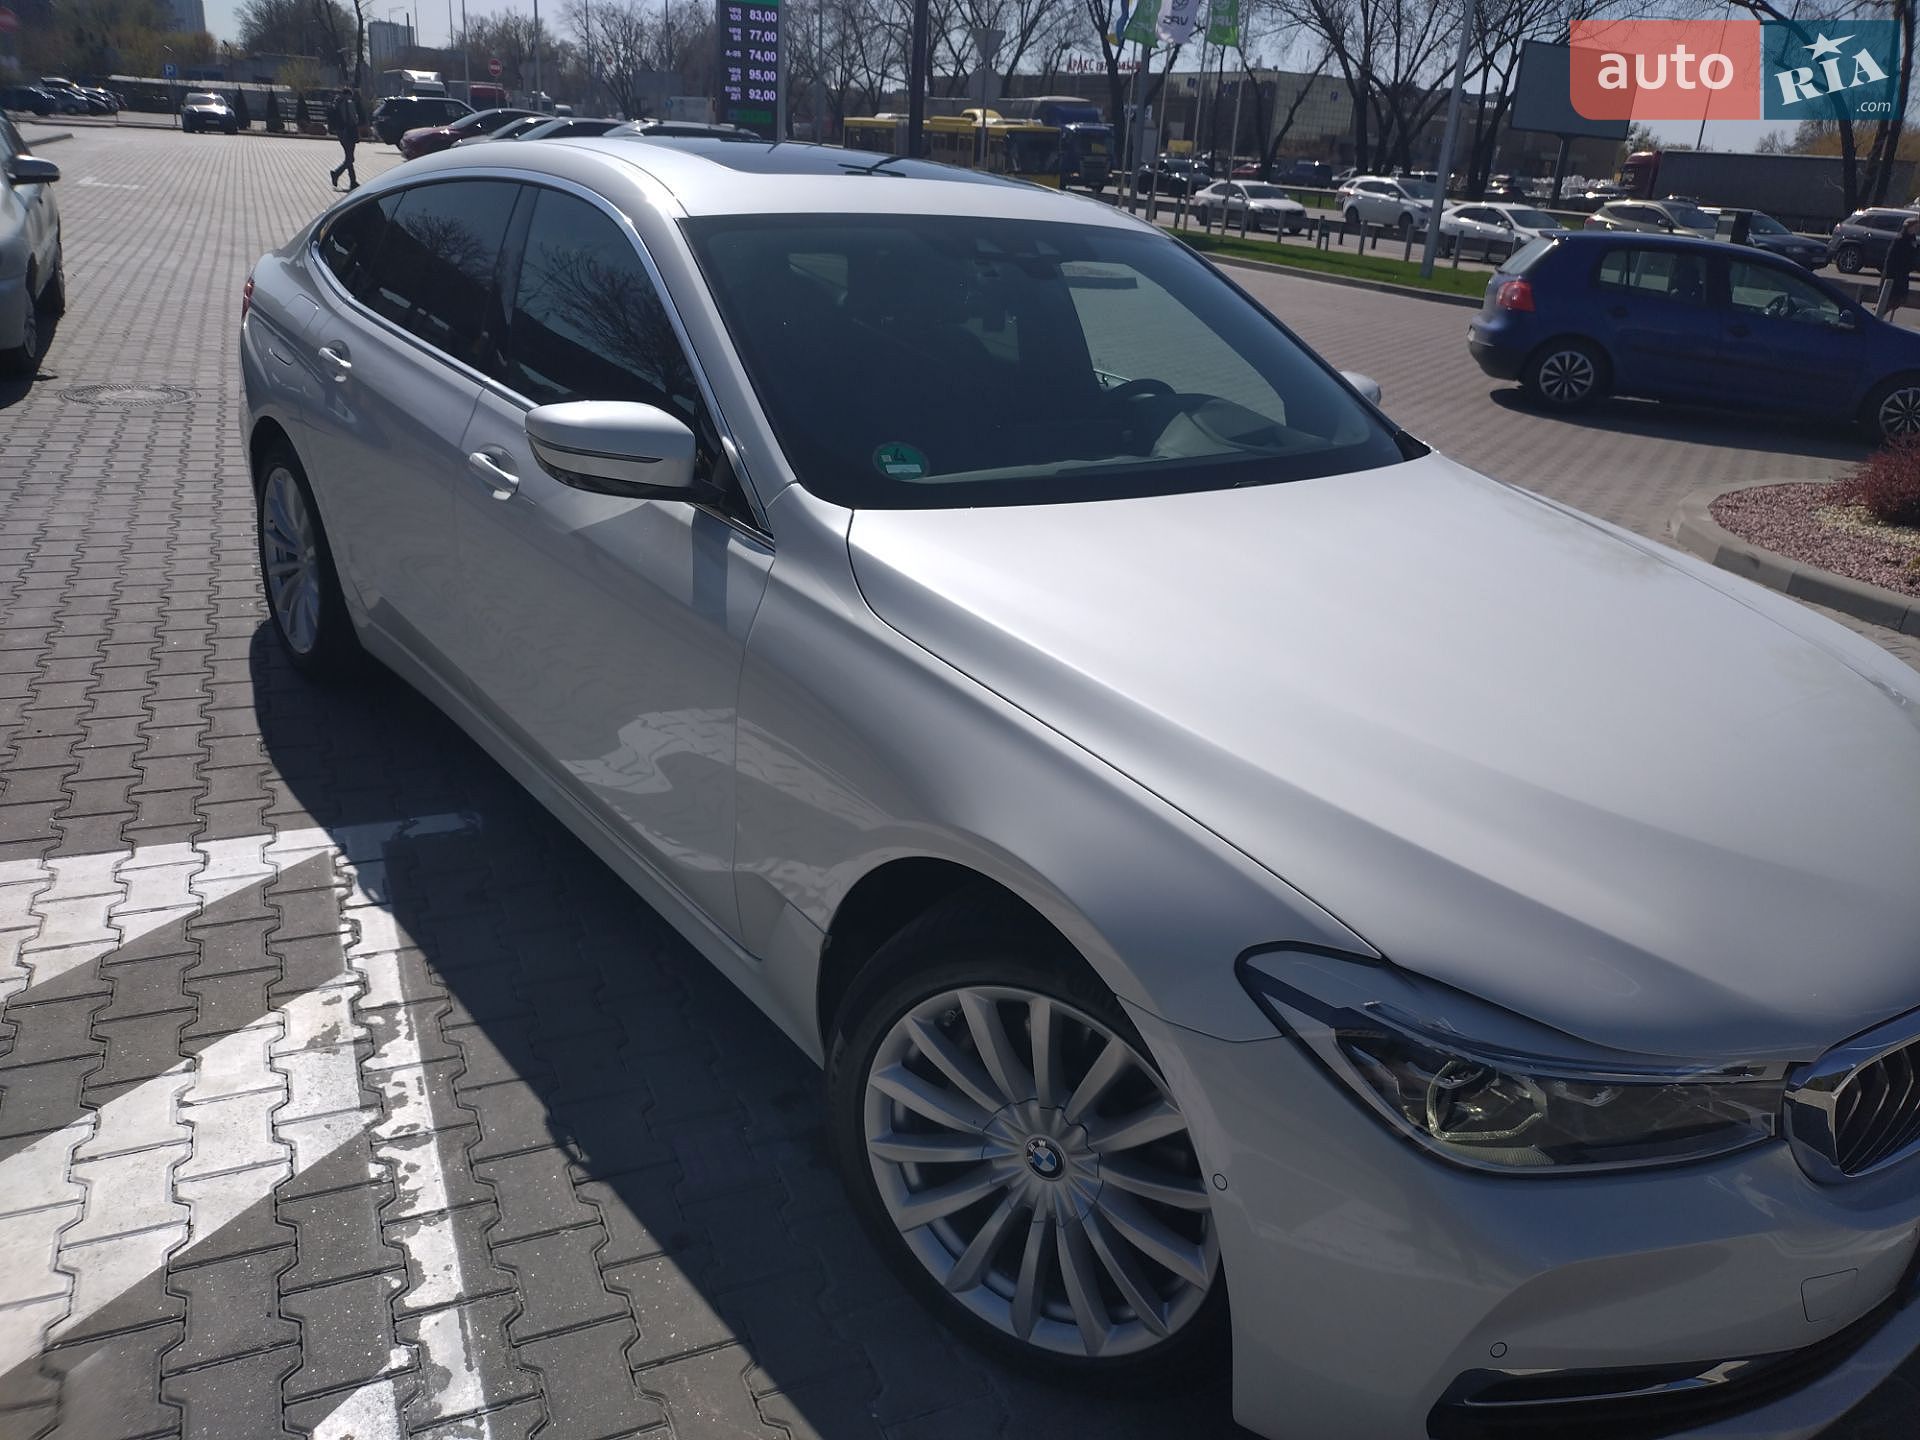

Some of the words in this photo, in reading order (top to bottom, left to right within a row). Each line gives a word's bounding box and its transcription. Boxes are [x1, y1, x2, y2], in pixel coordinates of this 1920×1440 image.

[749, 9, 777, 23] 83,00
[749, 29, 777, 43] 77,00
[748, 49, 777, 63] 74,00
[748, 69, 777, 83] 95,00
[748, 88, 777, 102] 92,00
